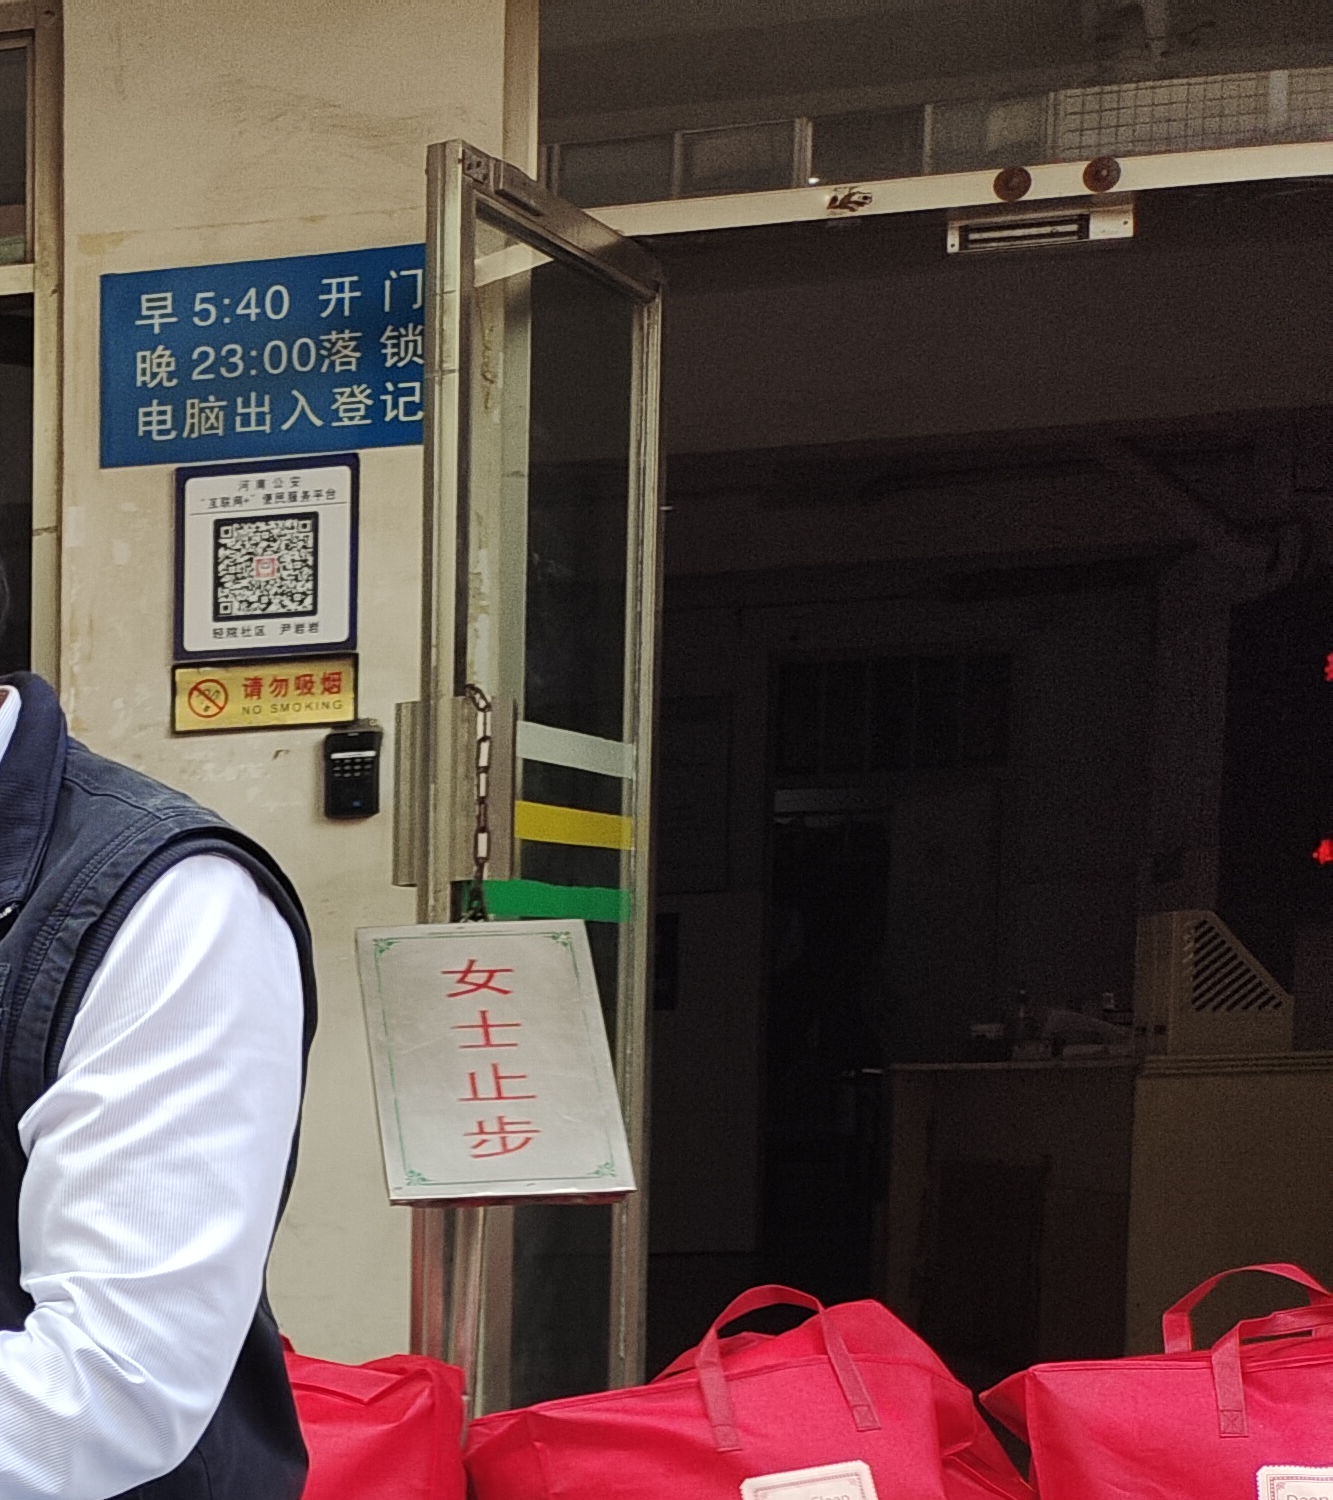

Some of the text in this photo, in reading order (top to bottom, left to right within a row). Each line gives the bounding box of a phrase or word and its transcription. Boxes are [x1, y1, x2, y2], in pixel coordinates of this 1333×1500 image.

[134, 292, 179, 334] 早
[192, 285, 290, 327] 5:40
[136, 345, 178, 389] 晚
[136, 381, 424, 441] 电脑出入登记
[241, 671, 343, 700] 请勿吸烟
[241, 700, 343, 716] NO SMOKING
[441, 958, 541, 1159] 女士止步
